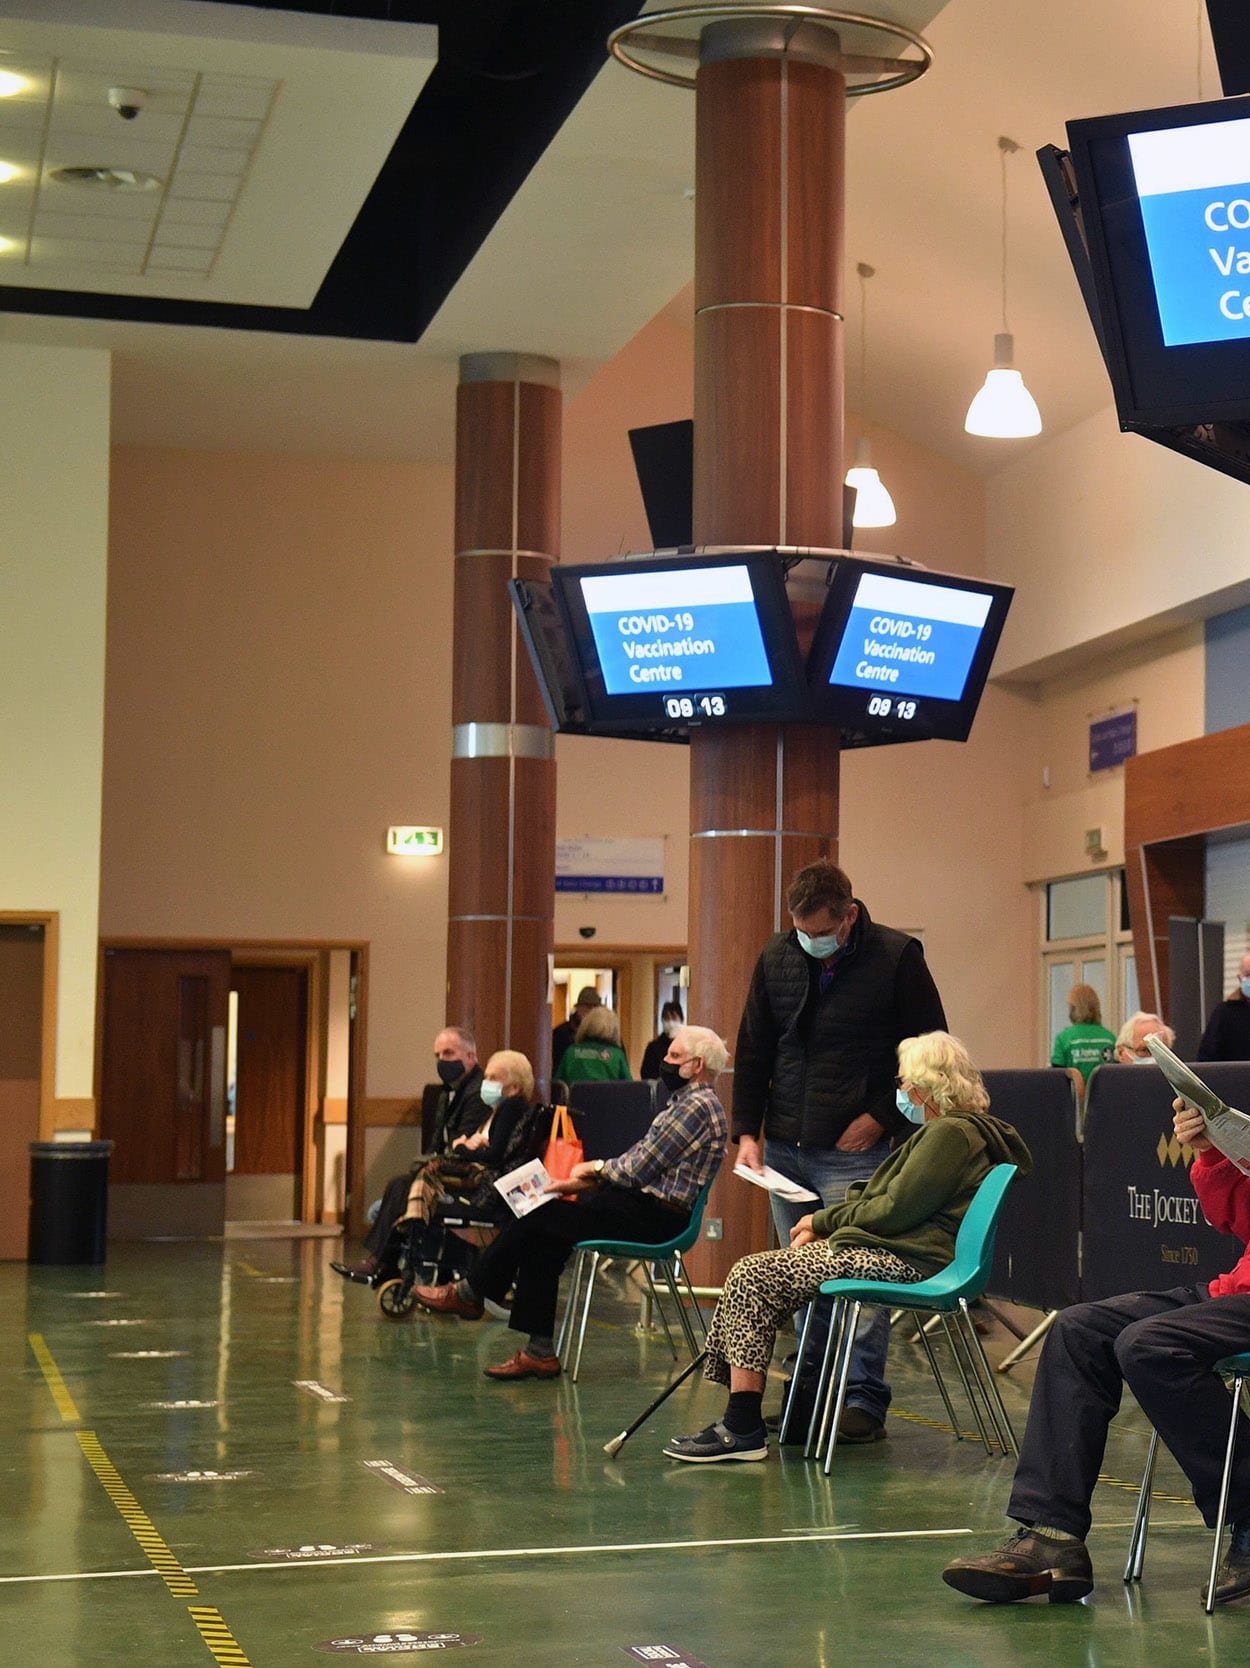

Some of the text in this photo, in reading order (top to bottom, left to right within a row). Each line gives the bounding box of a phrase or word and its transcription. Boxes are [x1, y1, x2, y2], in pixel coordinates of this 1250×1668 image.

[618, 613, 694, 635] COVID-19
[869, 616, 932, 640] COVID-19
[623, 637, 715, 658] Vaccination
[863, 639, 936, 664] Vaccination
[630, 665, 682, 683] Centre
[855, 661, 899, 682] Centre
[667, 696, 726, 718] 09 13
[868, 697, 917, 719] 09 13
